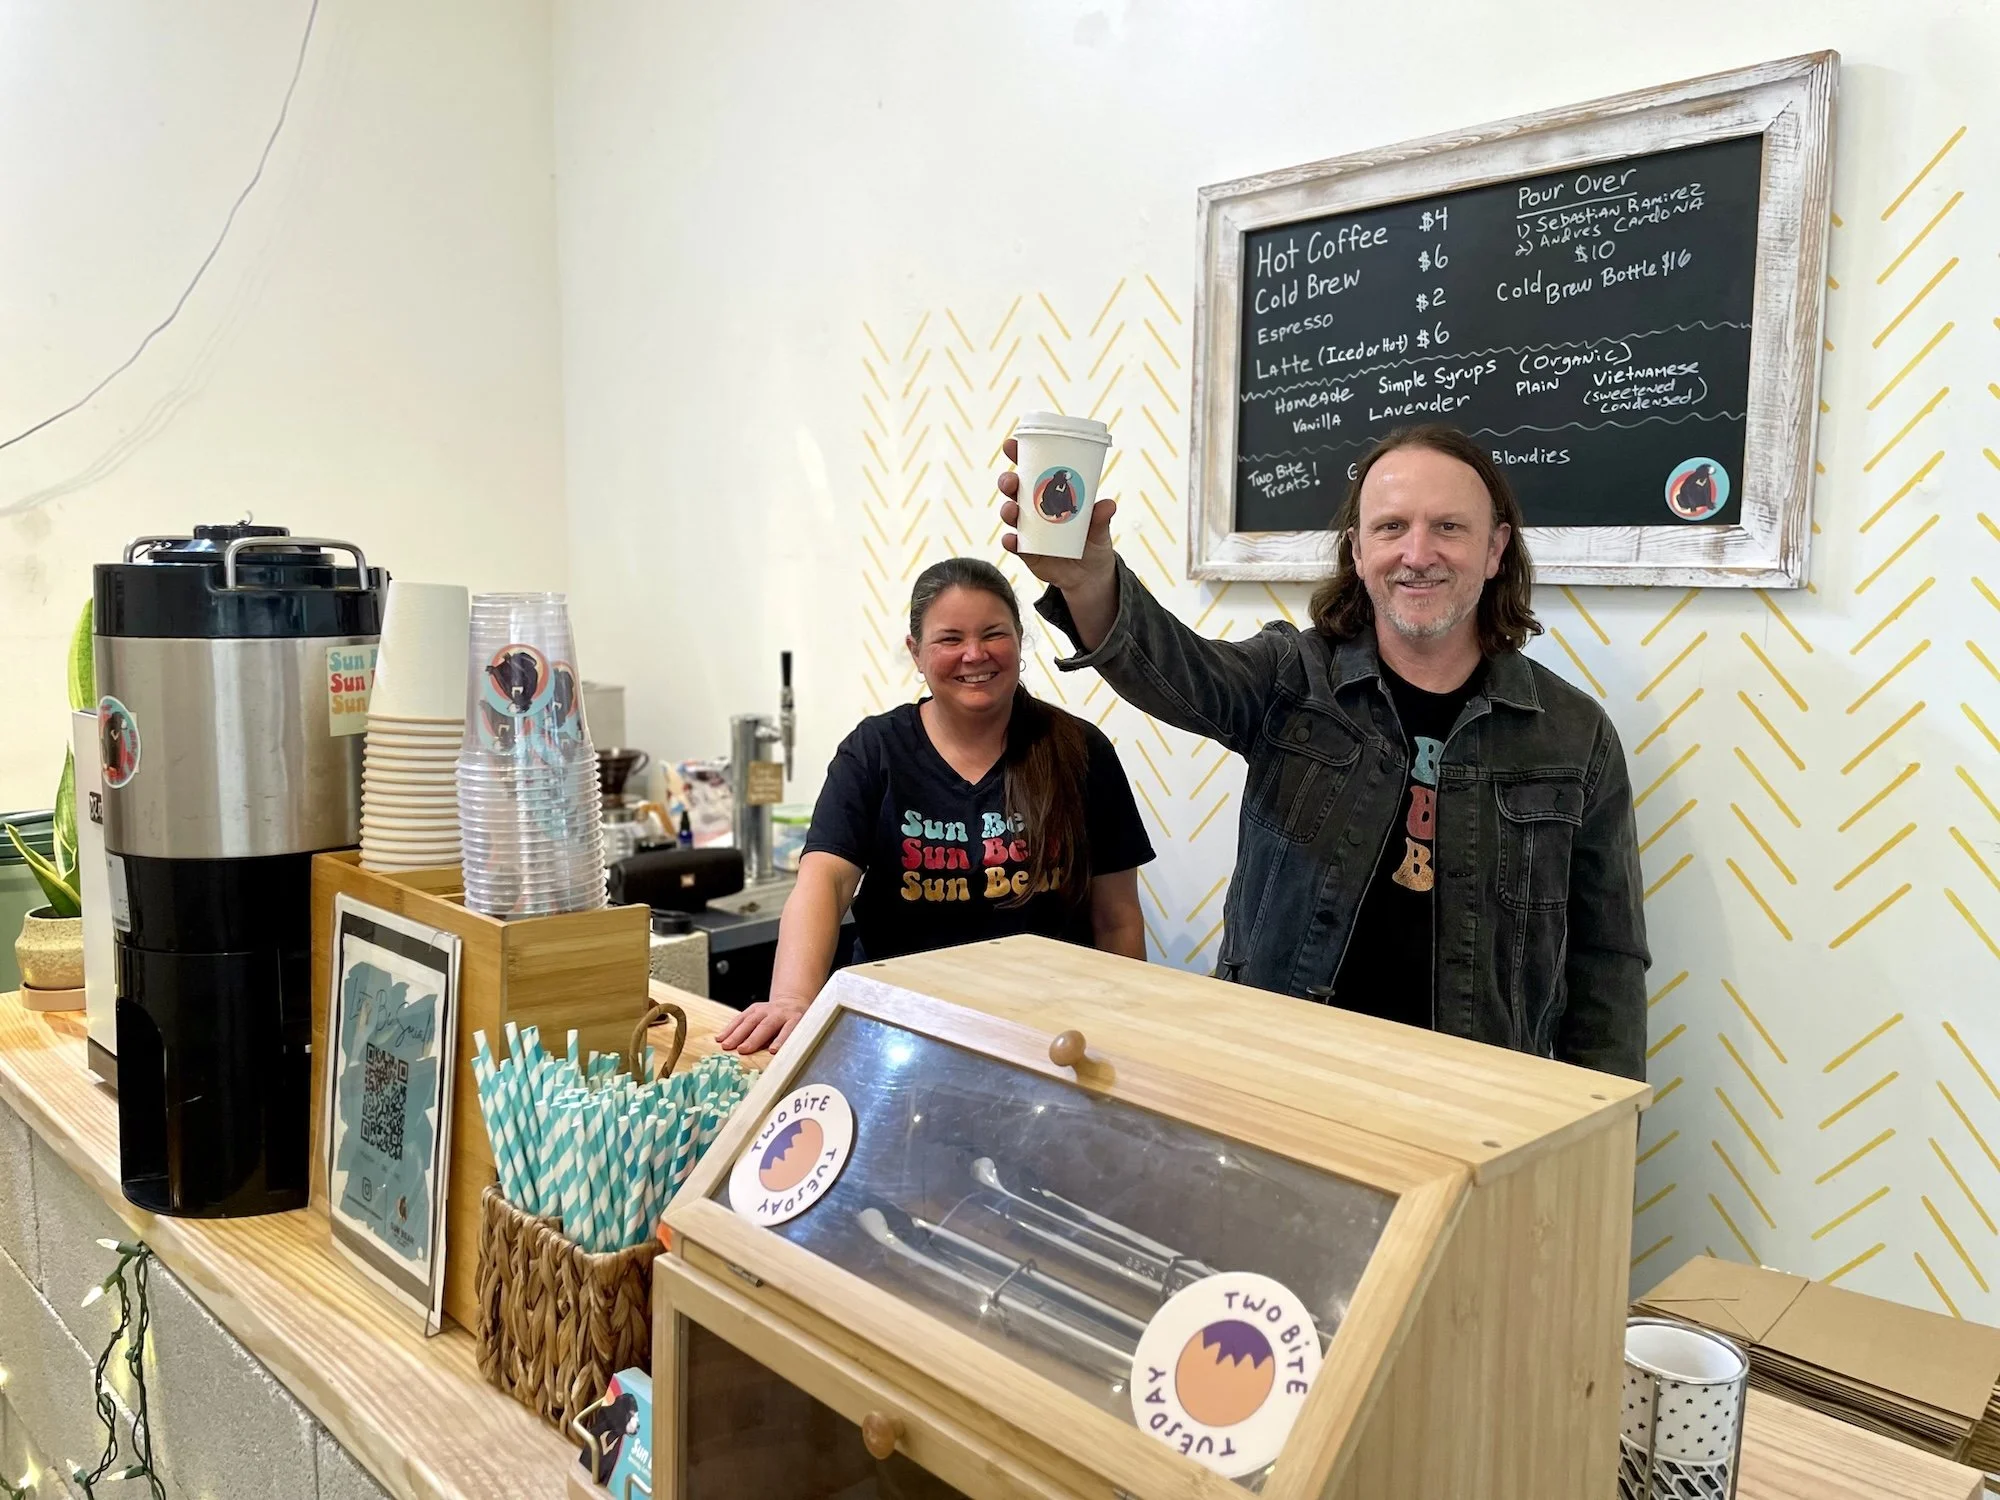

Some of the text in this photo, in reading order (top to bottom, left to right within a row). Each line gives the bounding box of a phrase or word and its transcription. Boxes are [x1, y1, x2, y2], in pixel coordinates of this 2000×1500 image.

[1518, 168, 1637, 210] Pour Over
[1257, 206, 1449, 277] Hot Coffee $4
[1574, 240, 1616, 263] $10
[1255, 243, 1449, 315] Cold Brew $6
[1496, 248, 1692, 305] Cold Brew Bottle $16
[1257, 287, 1447, 345] Espresso $2
[1416, 321, 1449, 348] $6
[1378, 369, 1428, 397] Simple
[1433, 359, 1497, 390] Syrups
[1247, 461, 1306, 488] Two Bite
[329, 651, 365, 672] Sun
[330, 673, 366, 694] Sun
[331, 694, 368, 715] Sun
[901, 809, 969, 842] Sun
[901, 837, 971, 870] Sun
[901, 870, 971, 902] Sun
[751, 1111, 787, 1153] TWO
[757, 1148, 838, 1216] TUESDAY
[1224, 1291, 1283, 1323] TWO
[1145, 1366, 1237, 1457] TUESDAY
